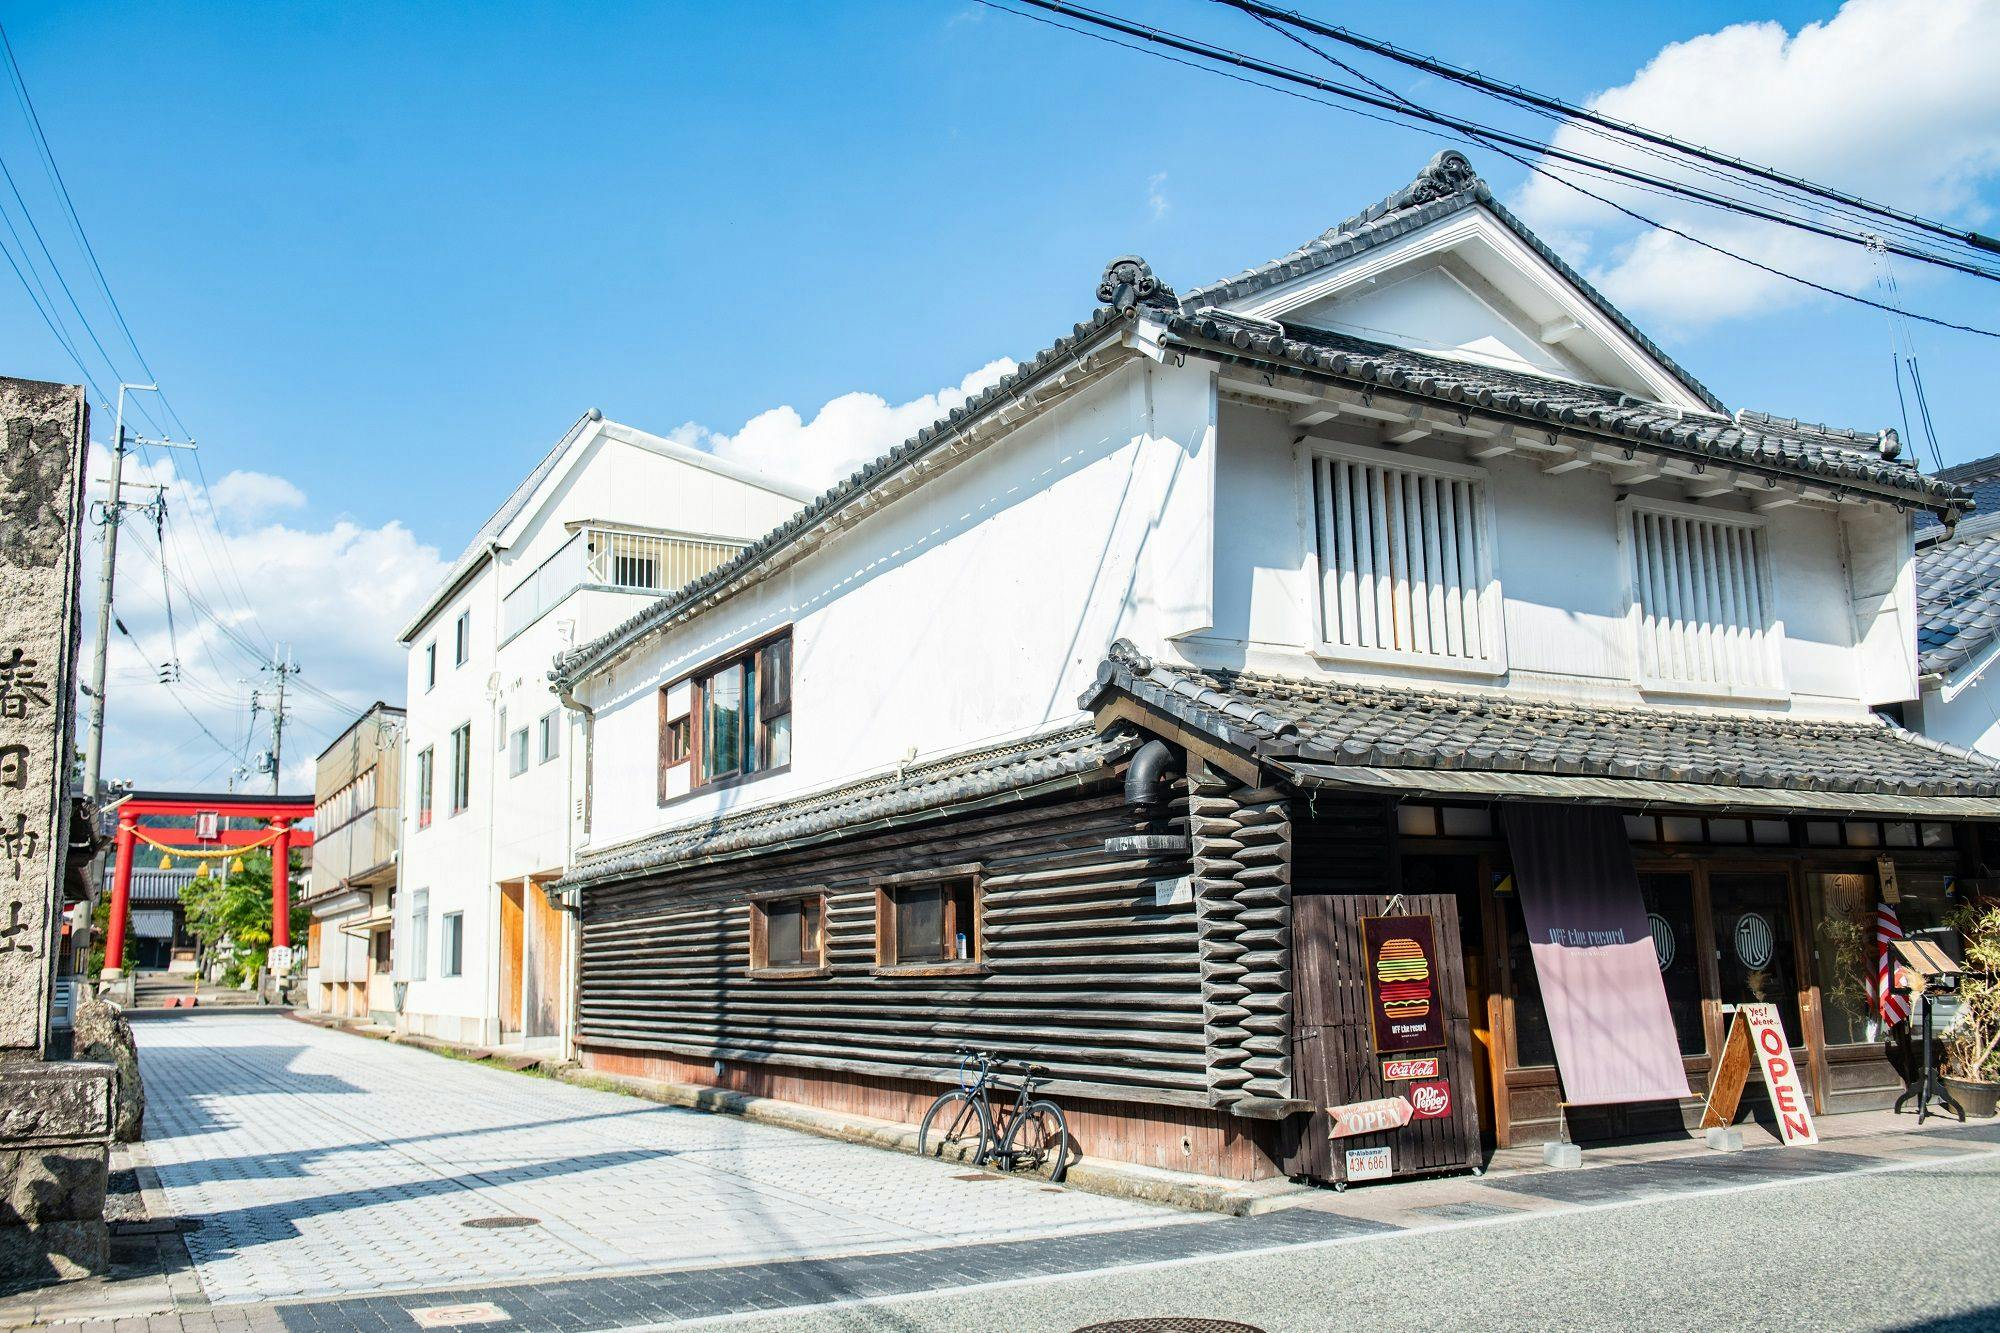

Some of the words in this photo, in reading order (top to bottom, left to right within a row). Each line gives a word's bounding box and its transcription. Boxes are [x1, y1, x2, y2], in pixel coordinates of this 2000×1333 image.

[1567, 928, 1587, 945] the
[1587, 927, 1625, 945] record
[1748, 1006, 1768, 1018] Yes!
[1400, 1024, 1410, 1033] the
[1410, 1022, 1427, 1033] record
[1760, 1028, 1810, 1140] OPEN
[1416, 1087, 1446, 1112] Pepper
[1426, 1086, 1438, 1099] Dr
[1349, 1106, 1402, 1133] OPEN
[1357, 1149, 1383, 1157] Alabama
[1368, 1155, 1388, 1171] 6861
